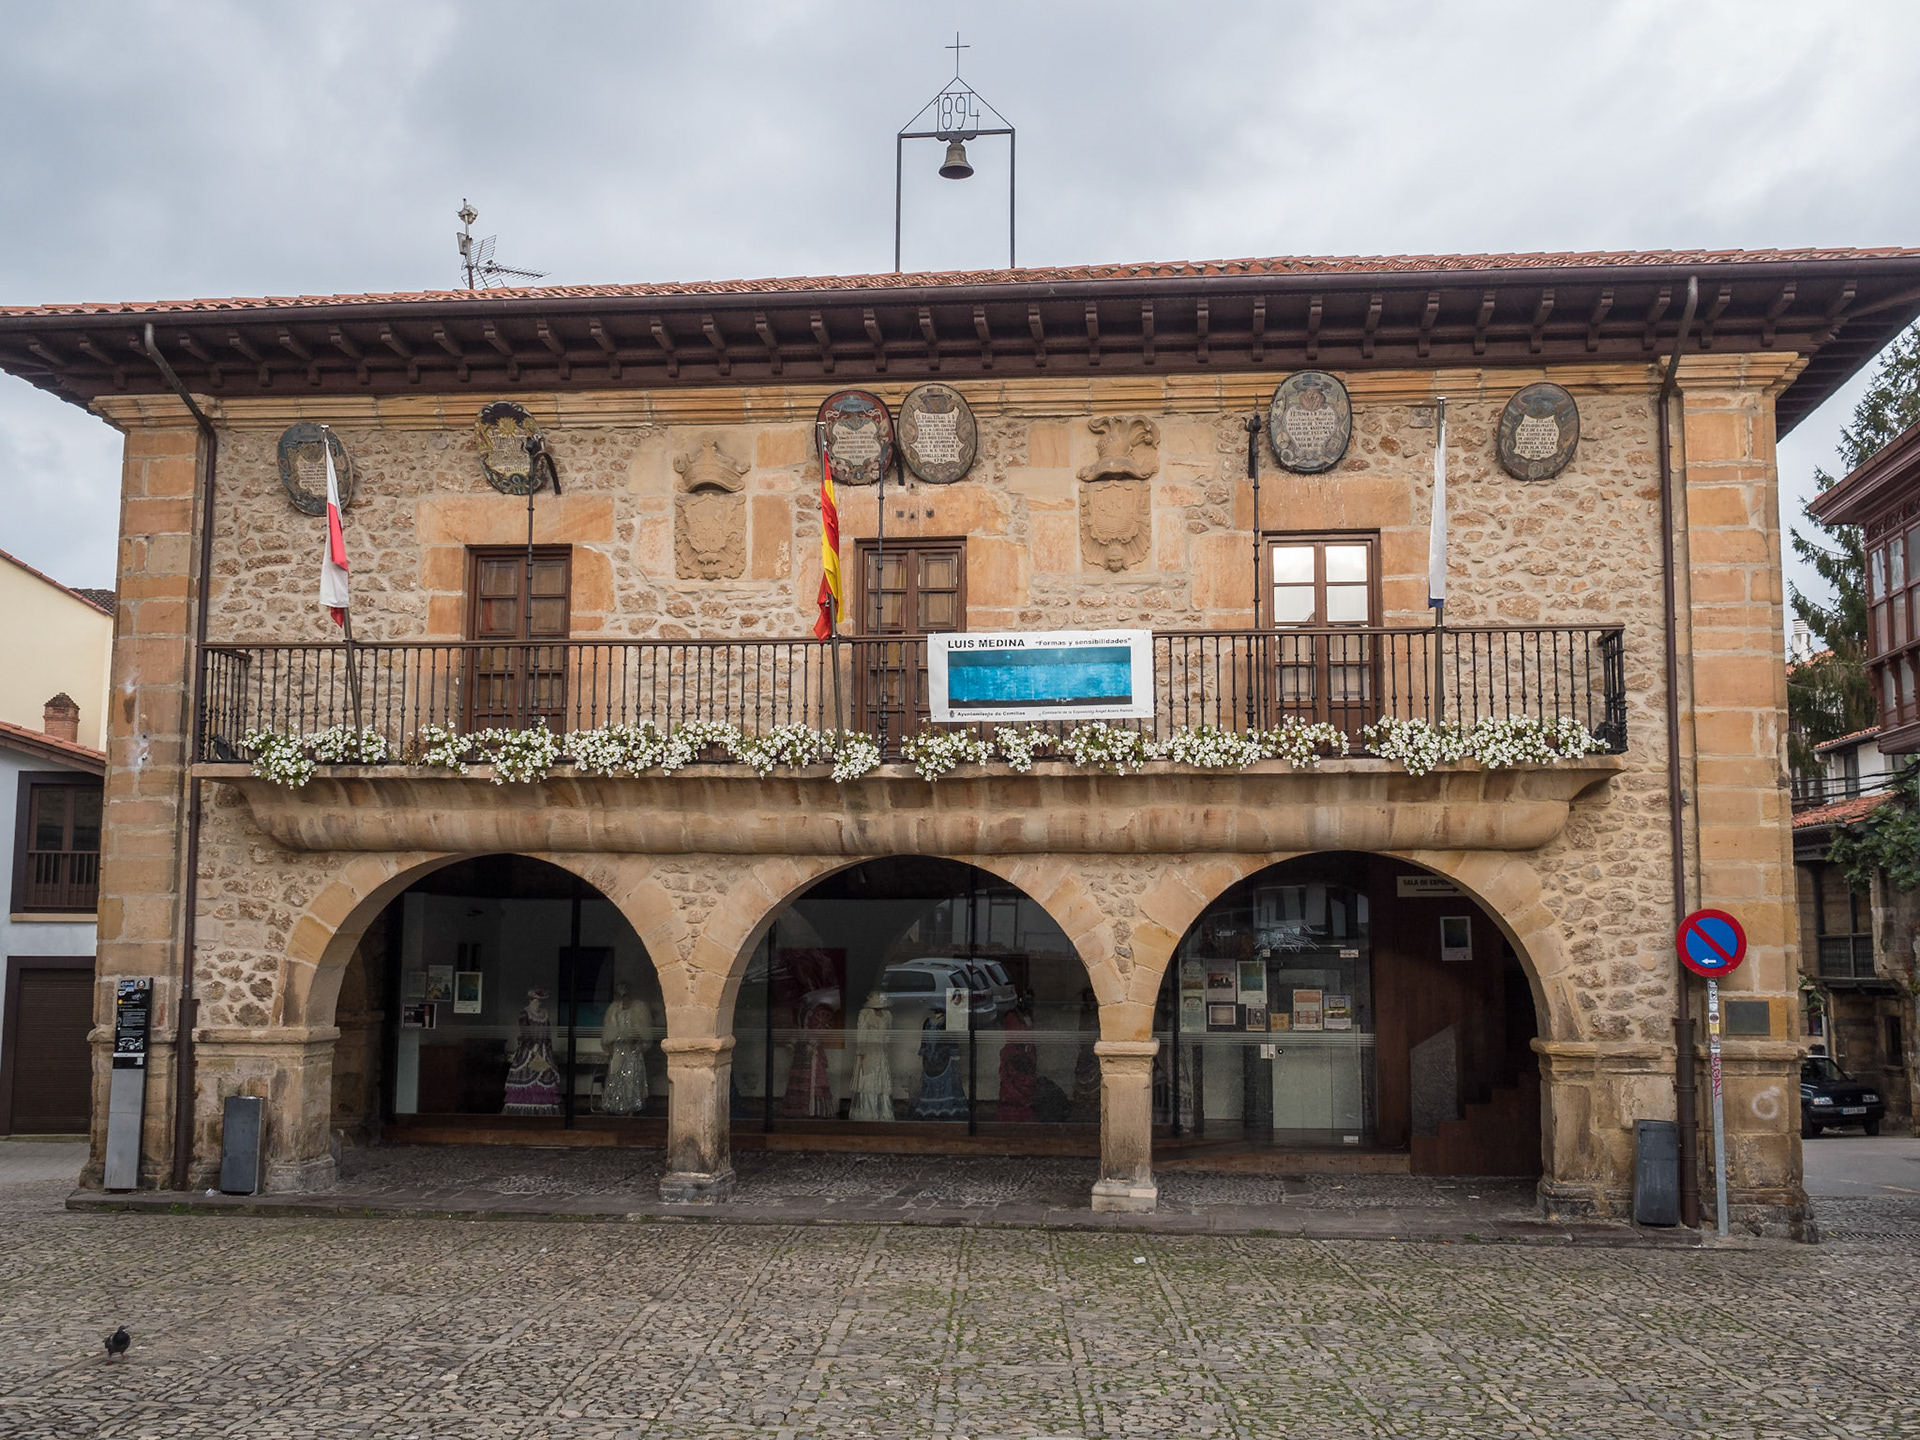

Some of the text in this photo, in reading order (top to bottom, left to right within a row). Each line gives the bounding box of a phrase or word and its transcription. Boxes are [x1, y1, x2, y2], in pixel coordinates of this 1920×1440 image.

[933, 92, 981, 132] 1894
[947, 639, 975, 649] LUIS
[978, 638, 1026, 648] MEDINA
